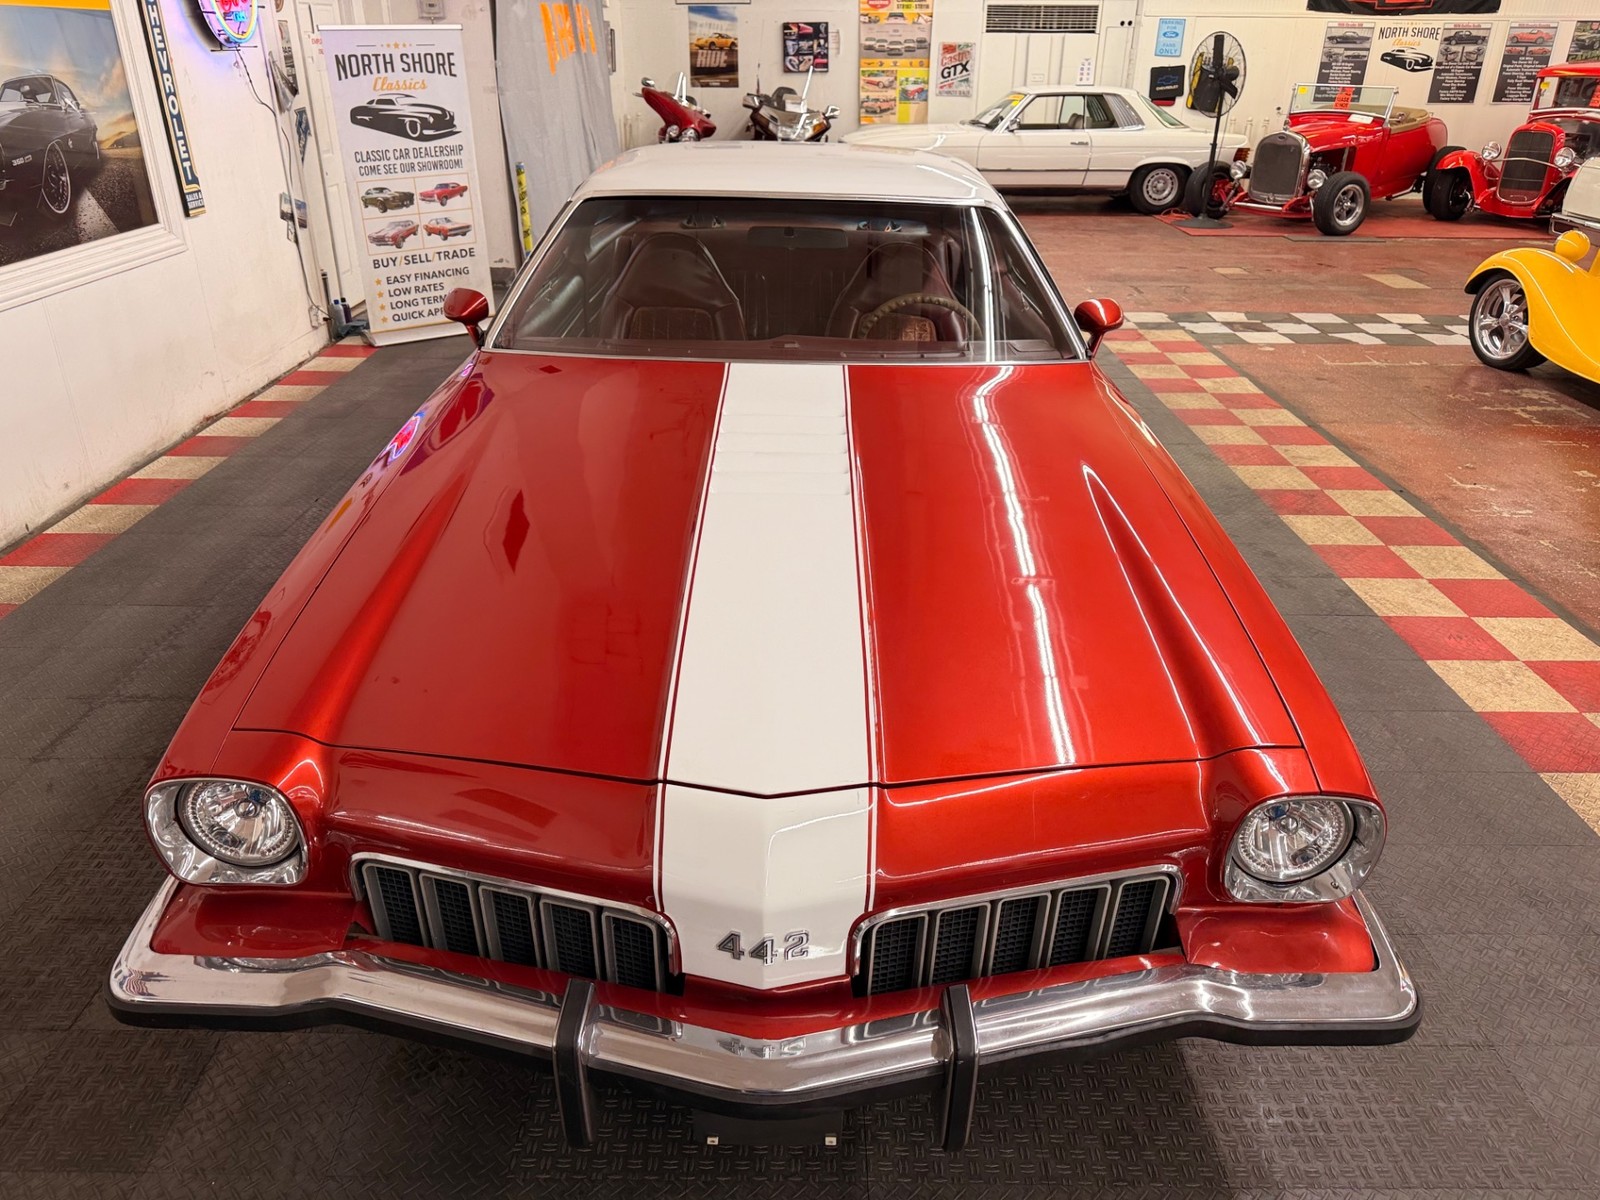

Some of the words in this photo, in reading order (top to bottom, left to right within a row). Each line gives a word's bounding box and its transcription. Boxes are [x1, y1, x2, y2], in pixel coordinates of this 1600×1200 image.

[1378, 27, 1408, 40] NORTH
[1411, 27, 1441, 40] SHORE
[334, 53, 395, 81] NORTH
[401, 52, 457, 77] SHORE
[697, 50, 728, 67] RIDE
[941, 60, 969, 79] GTX
[148, 0, 192, 180] HEVROLET
[373, 77, 427, 91] Classics
[354, 149, 391, 164] CLASSIC
[393, 148, 411, 161] CAR
[413, 144, 463, 159] DEALERSHIP
[359, 164, 382, 177] COME
[384, 163, 398, 175] SEE
[400, 162, 416, 173] OUR
[417, 159, 463, 172] SHOWROOM!
[386, 274, 411, 285] EASY
[414, 267, 470, 281] FINANCING
[388, 286, 414, 298] LOW
[415, 282, 445, 294] RATES
[390, 299, 419, 310] LONG
[392, 310, 425, 323] QUICK
[717, 929, 810, 966] 442
